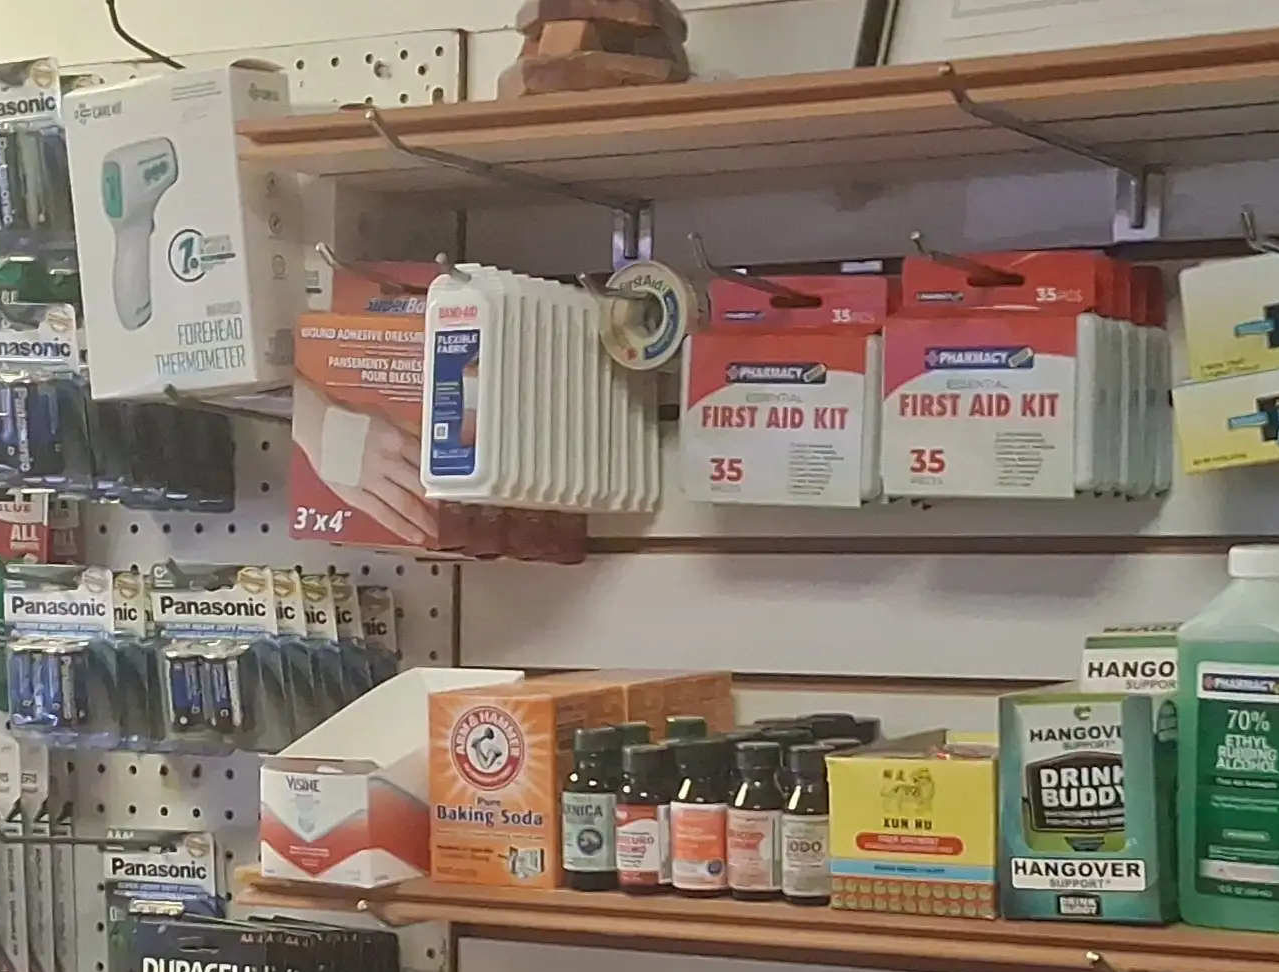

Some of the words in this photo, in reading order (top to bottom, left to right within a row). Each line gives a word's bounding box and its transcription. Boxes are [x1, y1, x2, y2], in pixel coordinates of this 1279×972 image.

[1035, 288, 1057, 302] 35
[177, 317, 244, 346] FOREHEAD
[337, 328, 383, 342] ADHESIVE
[437, 332, 479, 346] FLEXIBLE
[437, 343, 469, 355] FABRIC
[939, 350, 1008, 366] PHARMACY
[155, 345, 247, 375] THERMOMETER
[328, 356, 389, 371] PANSEMENTS
[899, 394, 959, 417] FIRST
[969, 394, 1011, 417] AID
[1022, 393, 1059, 417] KIT
[702, 407, 758, 429] FIRST
[766, 407, 804, 429] AID
[814, 407, 849, 429] KIT
[710, 458, 743, 482] 35
[910, 449, 946, 474] 35
[10, 525, 41, 542] ALL
[11, 596, 107, 618] Panasonic
[159, 595, 267, 619] Panasonic
[1087, 660, 1176, 680] HANGO
[1125, 679, 1178, 692] SUPPOR
[1226, 708, 1271, 733] 70%
[1029, 726, 1122, 743] HANGOV
[1226, 733, 1270, 749] ETHYL
[1215, 757, 1279, 774] ALCOHOL
[477, 796, 502, 807] Pure
[1040, 786, 1125, 809] BUDDY
[436, 804, 495, 828] Baking
[500, 808, 544, 827] Soda
[111, 858, 208, 879] Panasonic
[1013, 861, 1141, 880] HANGOVER
[1049, 878, 1109, 890] SUPPORT
